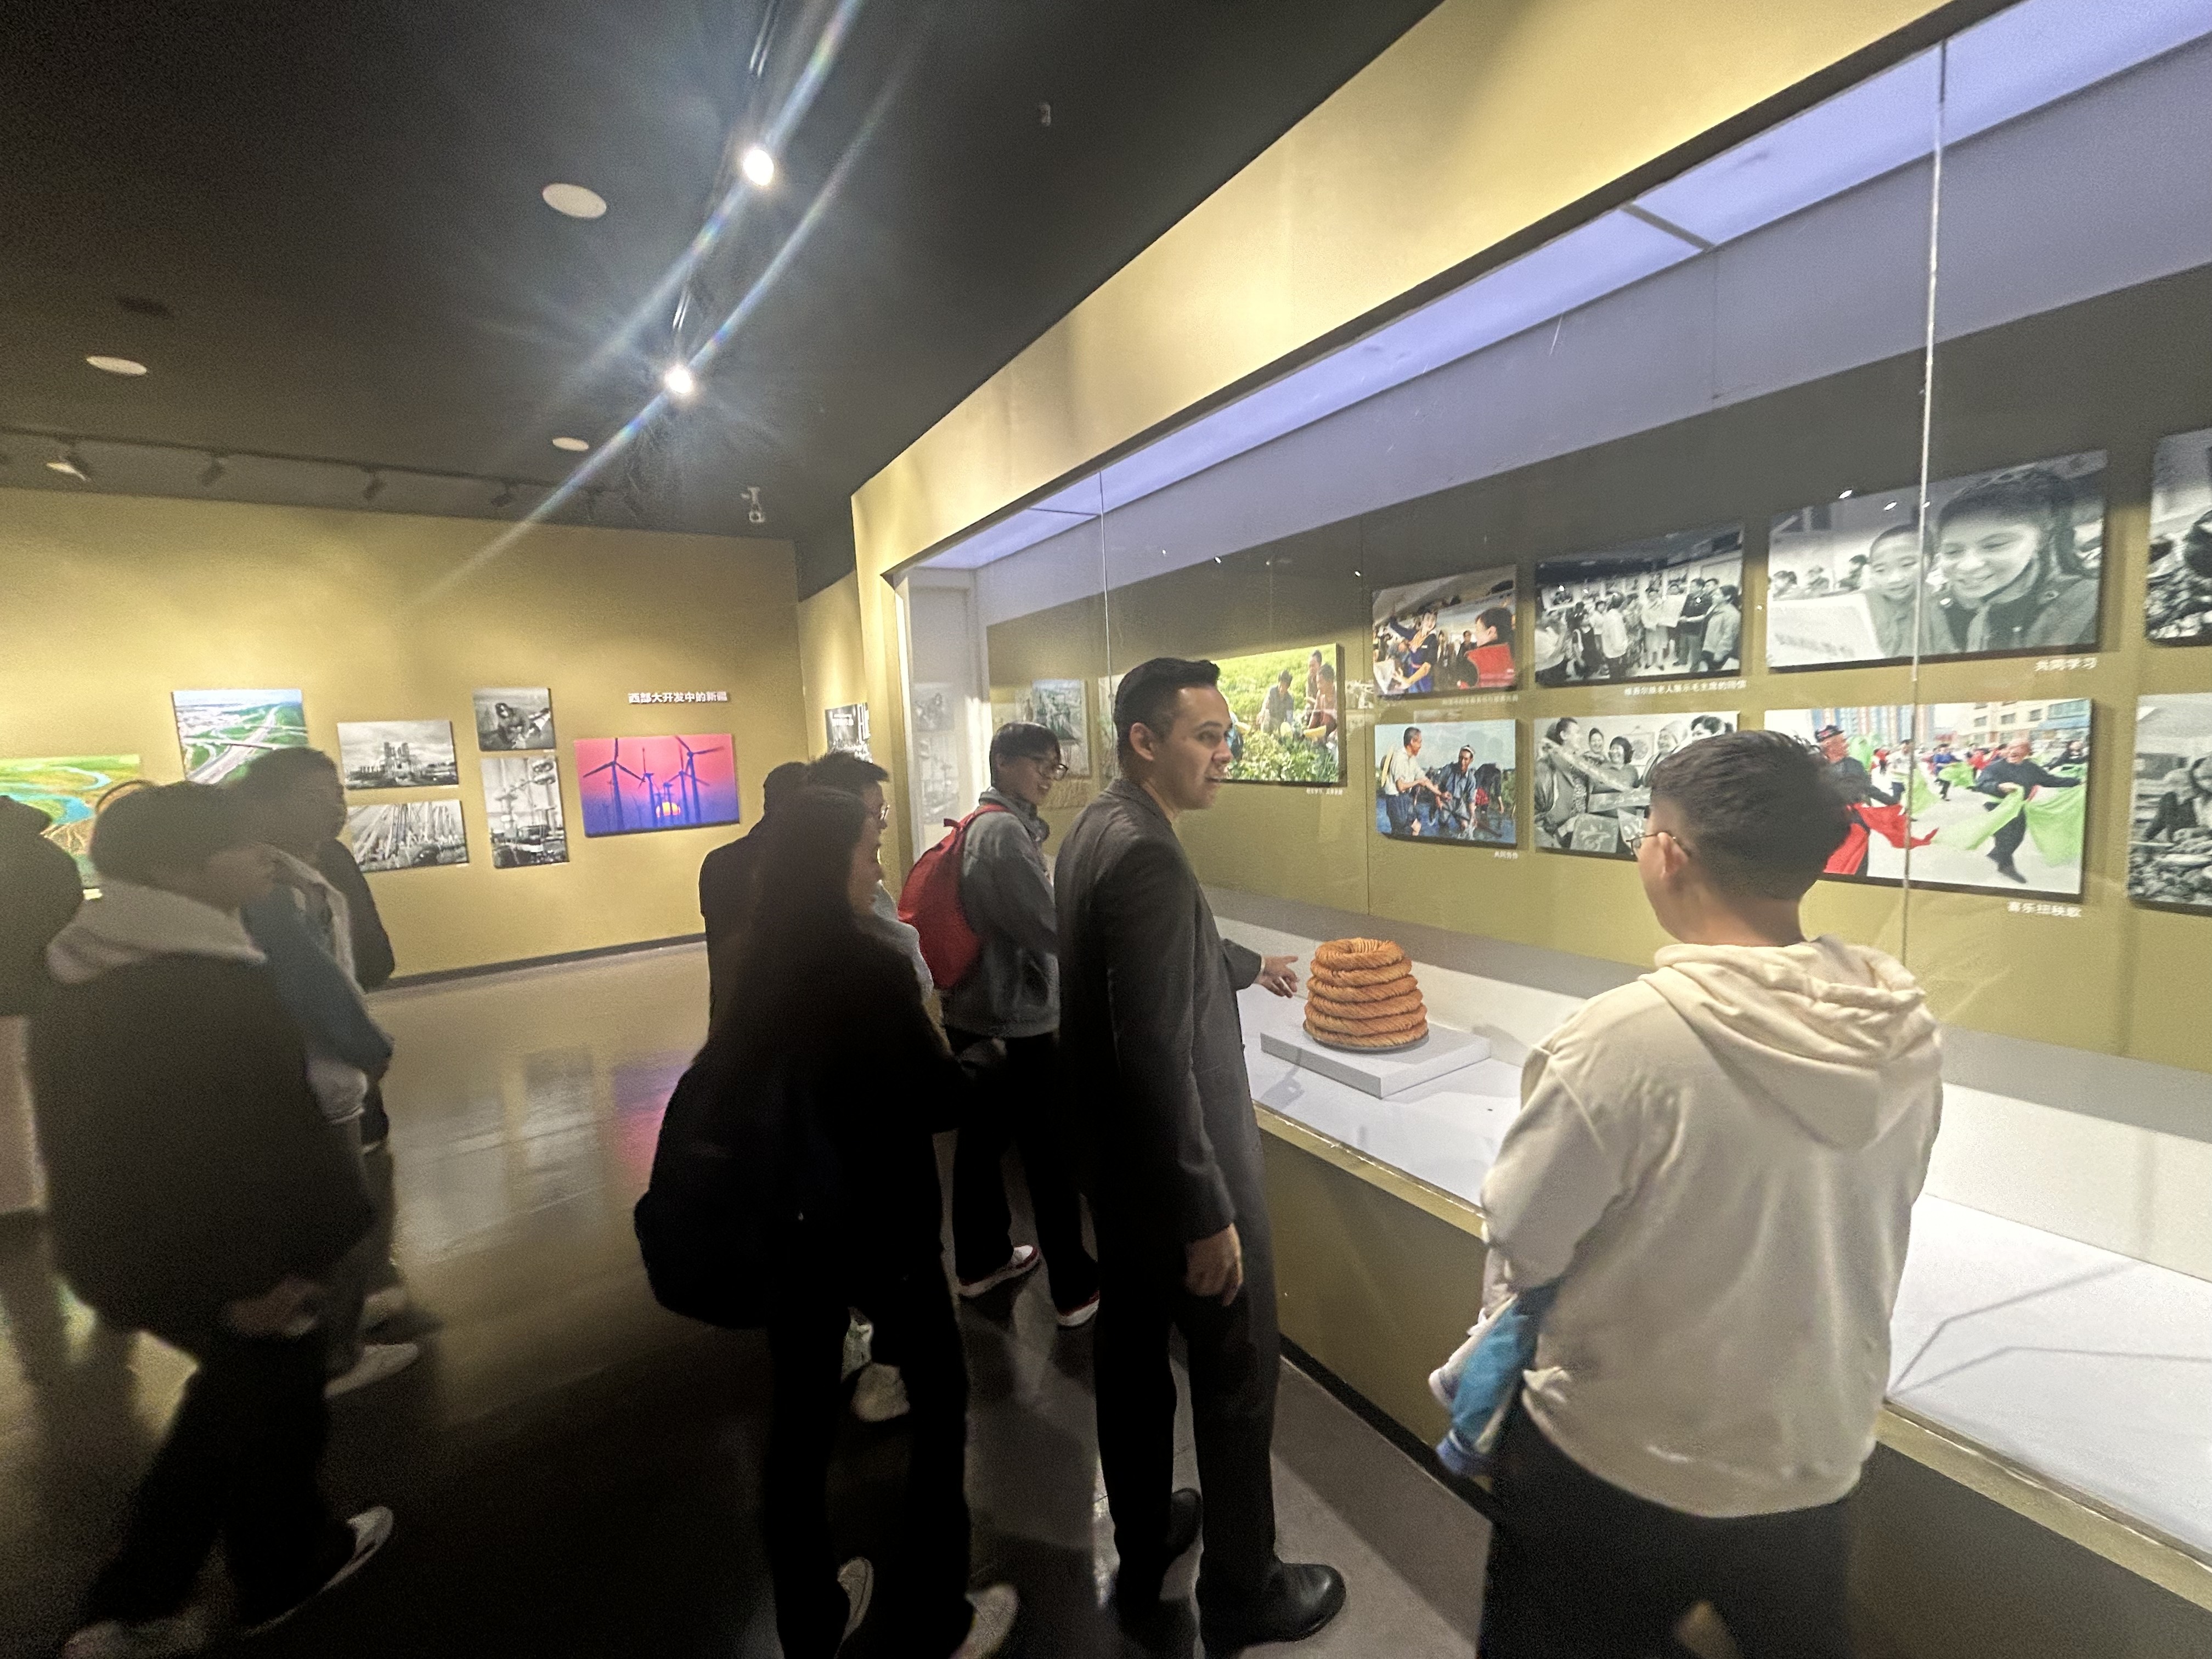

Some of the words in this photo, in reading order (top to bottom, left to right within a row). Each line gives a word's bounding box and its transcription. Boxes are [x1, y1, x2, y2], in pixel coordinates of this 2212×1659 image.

[628, 691, 728, 703] 西部大开发中的新疆
